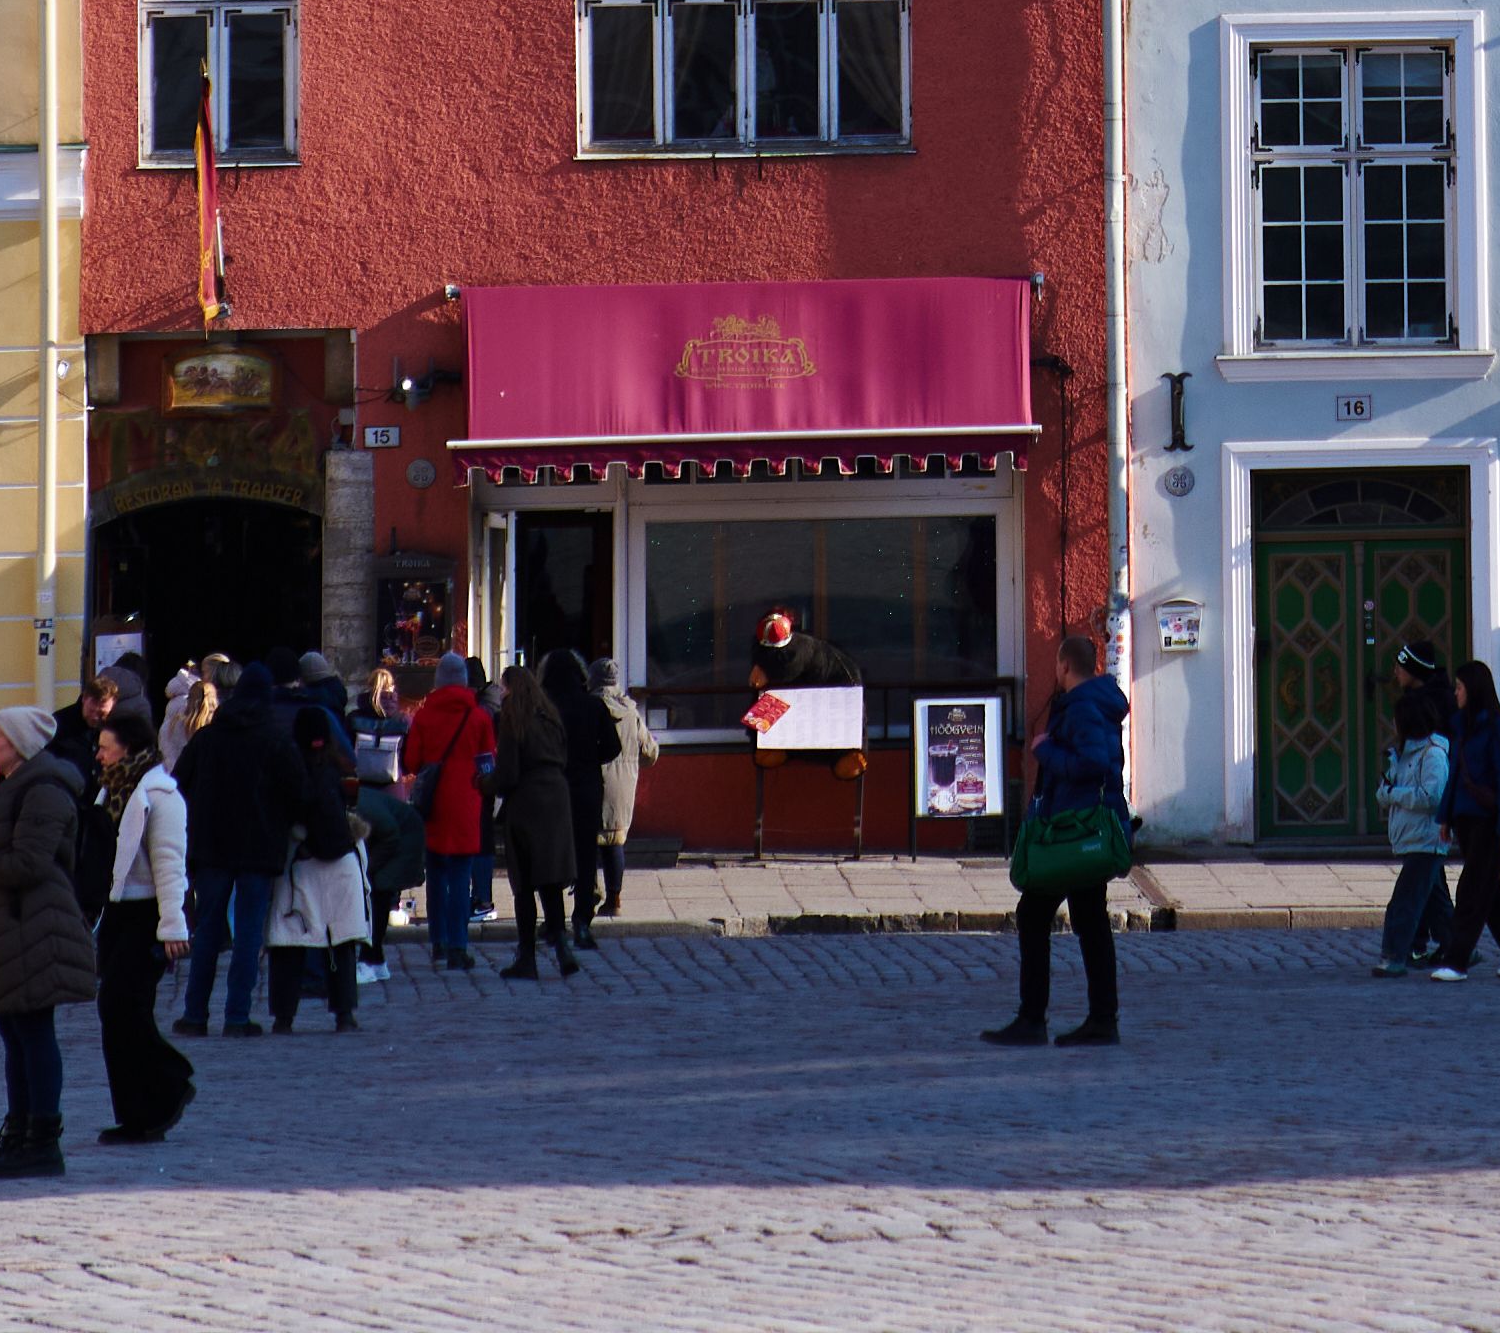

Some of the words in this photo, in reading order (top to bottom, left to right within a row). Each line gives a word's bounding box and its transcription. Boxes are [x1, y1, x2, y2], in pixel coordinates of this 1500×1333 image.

[696, 346, 796, 364] TROIKA
[1343, 399, 1366, 418] 16
[371, 429, 391, 446] 15
